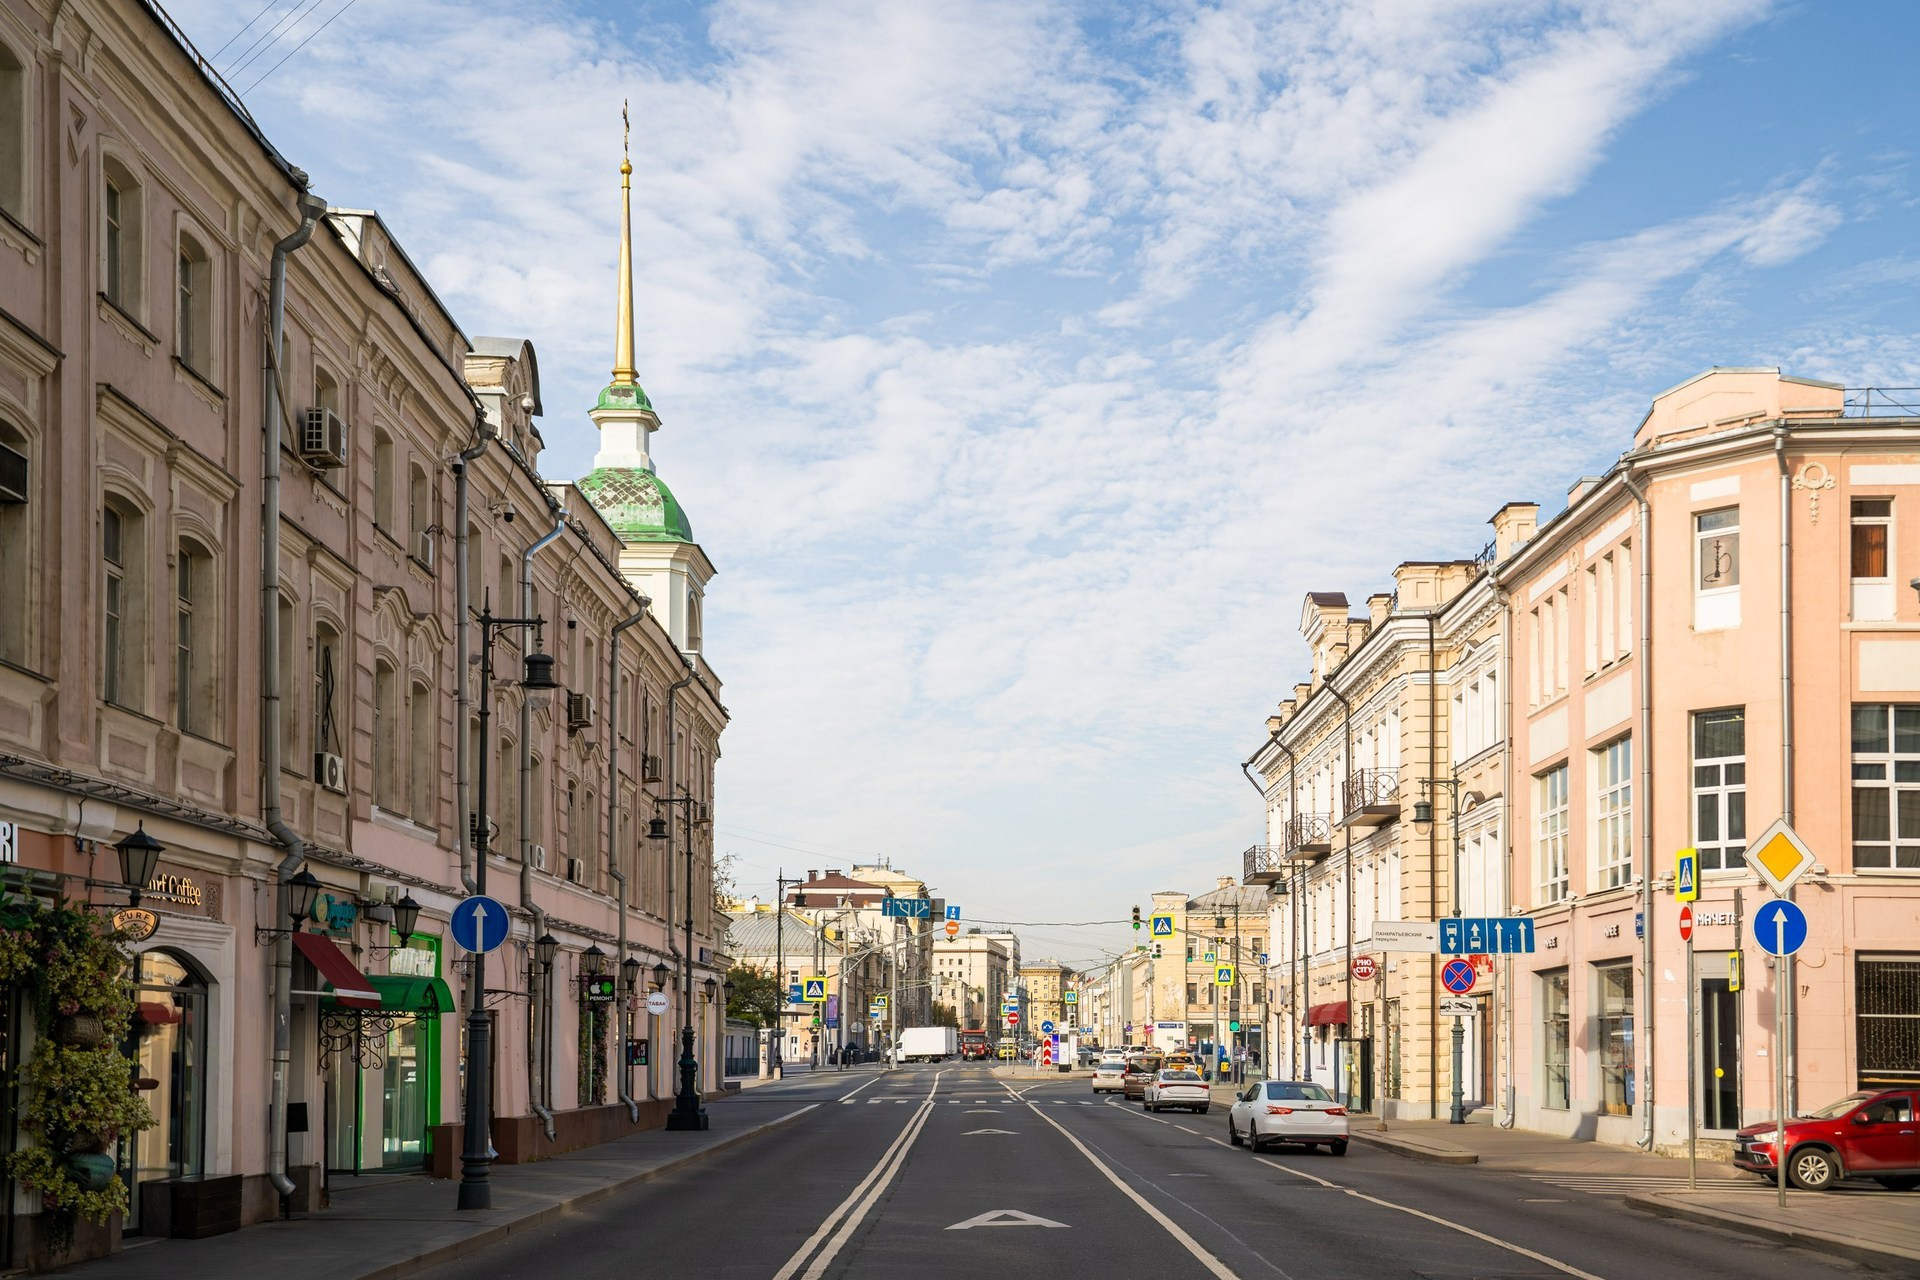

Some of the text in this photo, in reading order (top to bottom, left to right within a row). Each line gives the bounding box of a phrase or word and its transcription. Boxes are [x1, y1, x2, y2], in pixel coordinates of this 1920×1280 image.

[147, 873, 201, 906] urf Coffee
[118, 912, 150, 922] SURF
